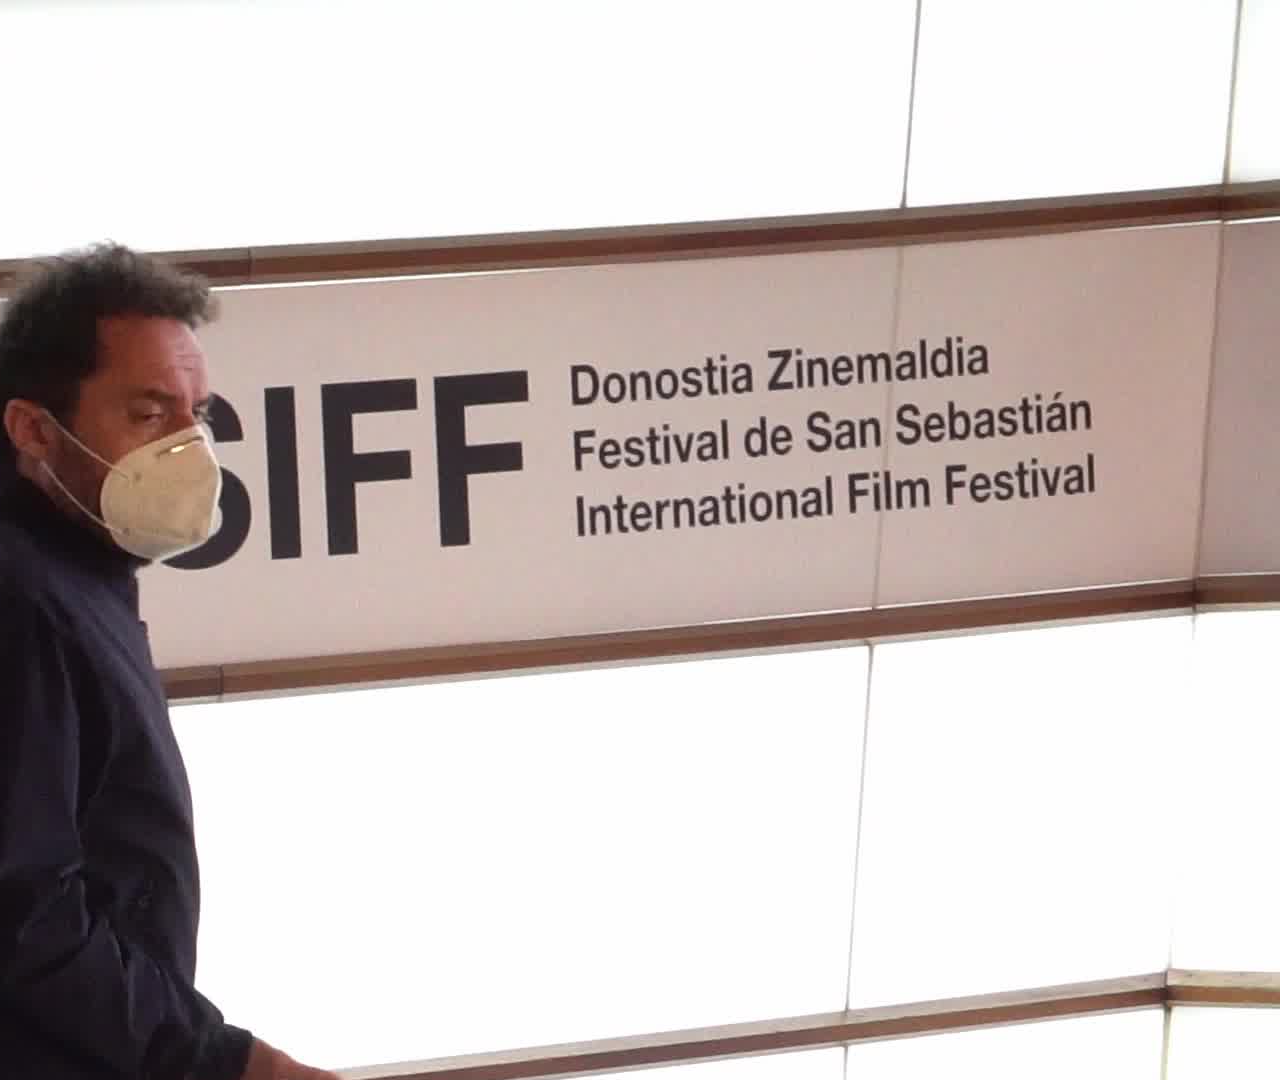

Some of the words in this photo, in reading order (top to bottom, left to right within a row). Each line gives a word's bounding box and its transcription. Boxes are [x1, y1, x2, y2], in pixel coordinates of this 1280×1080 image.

[570, 354, 753, 406] Donostia
[767, 336, 989, 391] Zinemaldia
[160, 370, 529, 570] IFF
[573, 419, 729, 471] Festival
[743, 416, 793, 457] de
[806, 411, 881, 452] San
[896, 392, 1092, 445] Sebastián
[576, 475, 833, 537] International
[848, 470, 930, 513] Film
[945, 453, 1095, 505] Festival
